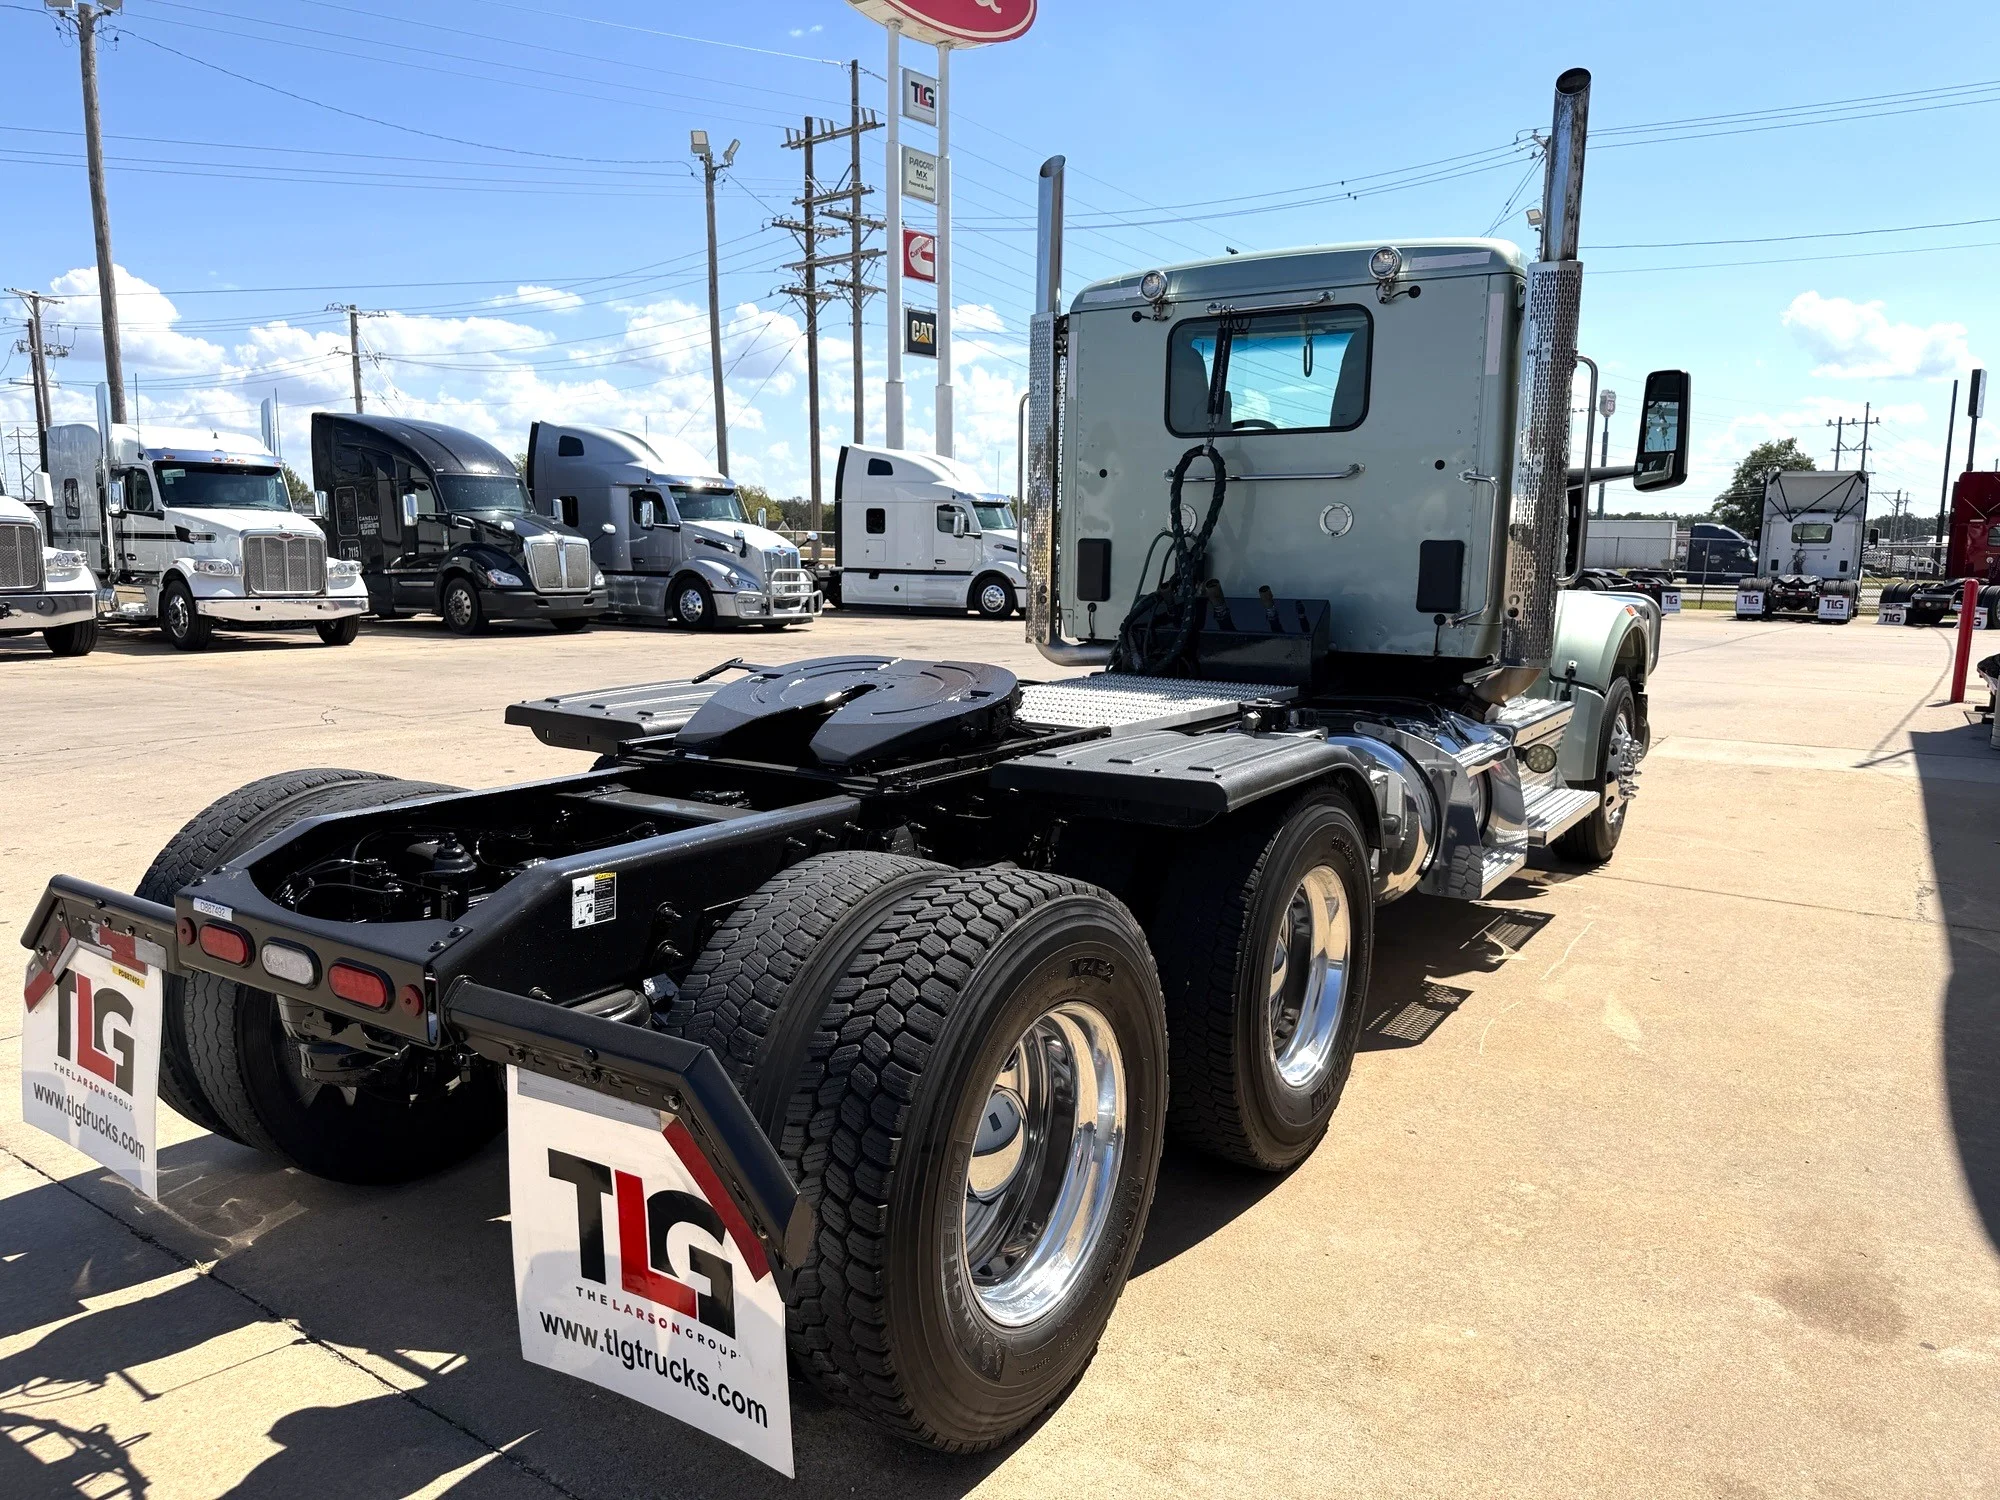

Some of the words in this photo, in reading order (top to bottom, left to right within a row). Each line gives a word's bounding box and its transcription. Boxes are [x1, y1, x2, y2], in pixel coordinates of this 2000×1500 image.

[911, 80, 935, 109] TLG
[909, 156, 935, 171] PACCAR
[916, 169, 928, 179] MX
[911, 319, 934, 344] CAT
[1665, 595, 1678, 604] TLG
[1741, 595, 1759, 604] TLG
[1825, 600, 1844, 609] TLG
[1883, 613, 1901, 622] TLG
[55, 967, 135, 1097] TLG
[54, 1062, 71, 1078] THE
[71, 1071, 105, 1097] LARSON
[108, 1091, 133, 1112] GROUP
[33, 1082, 145, 1163] www.tlgtrucks.com
[547, 1147, 736, 1340] TLG
[575, 1285, 608, 1306] THE
[612, 1299, 680, 1335] LARSON
[685, 1328, 737, 1359] GROUP
[540, 1311, 768, 1429] www.tlgtrucks.com
